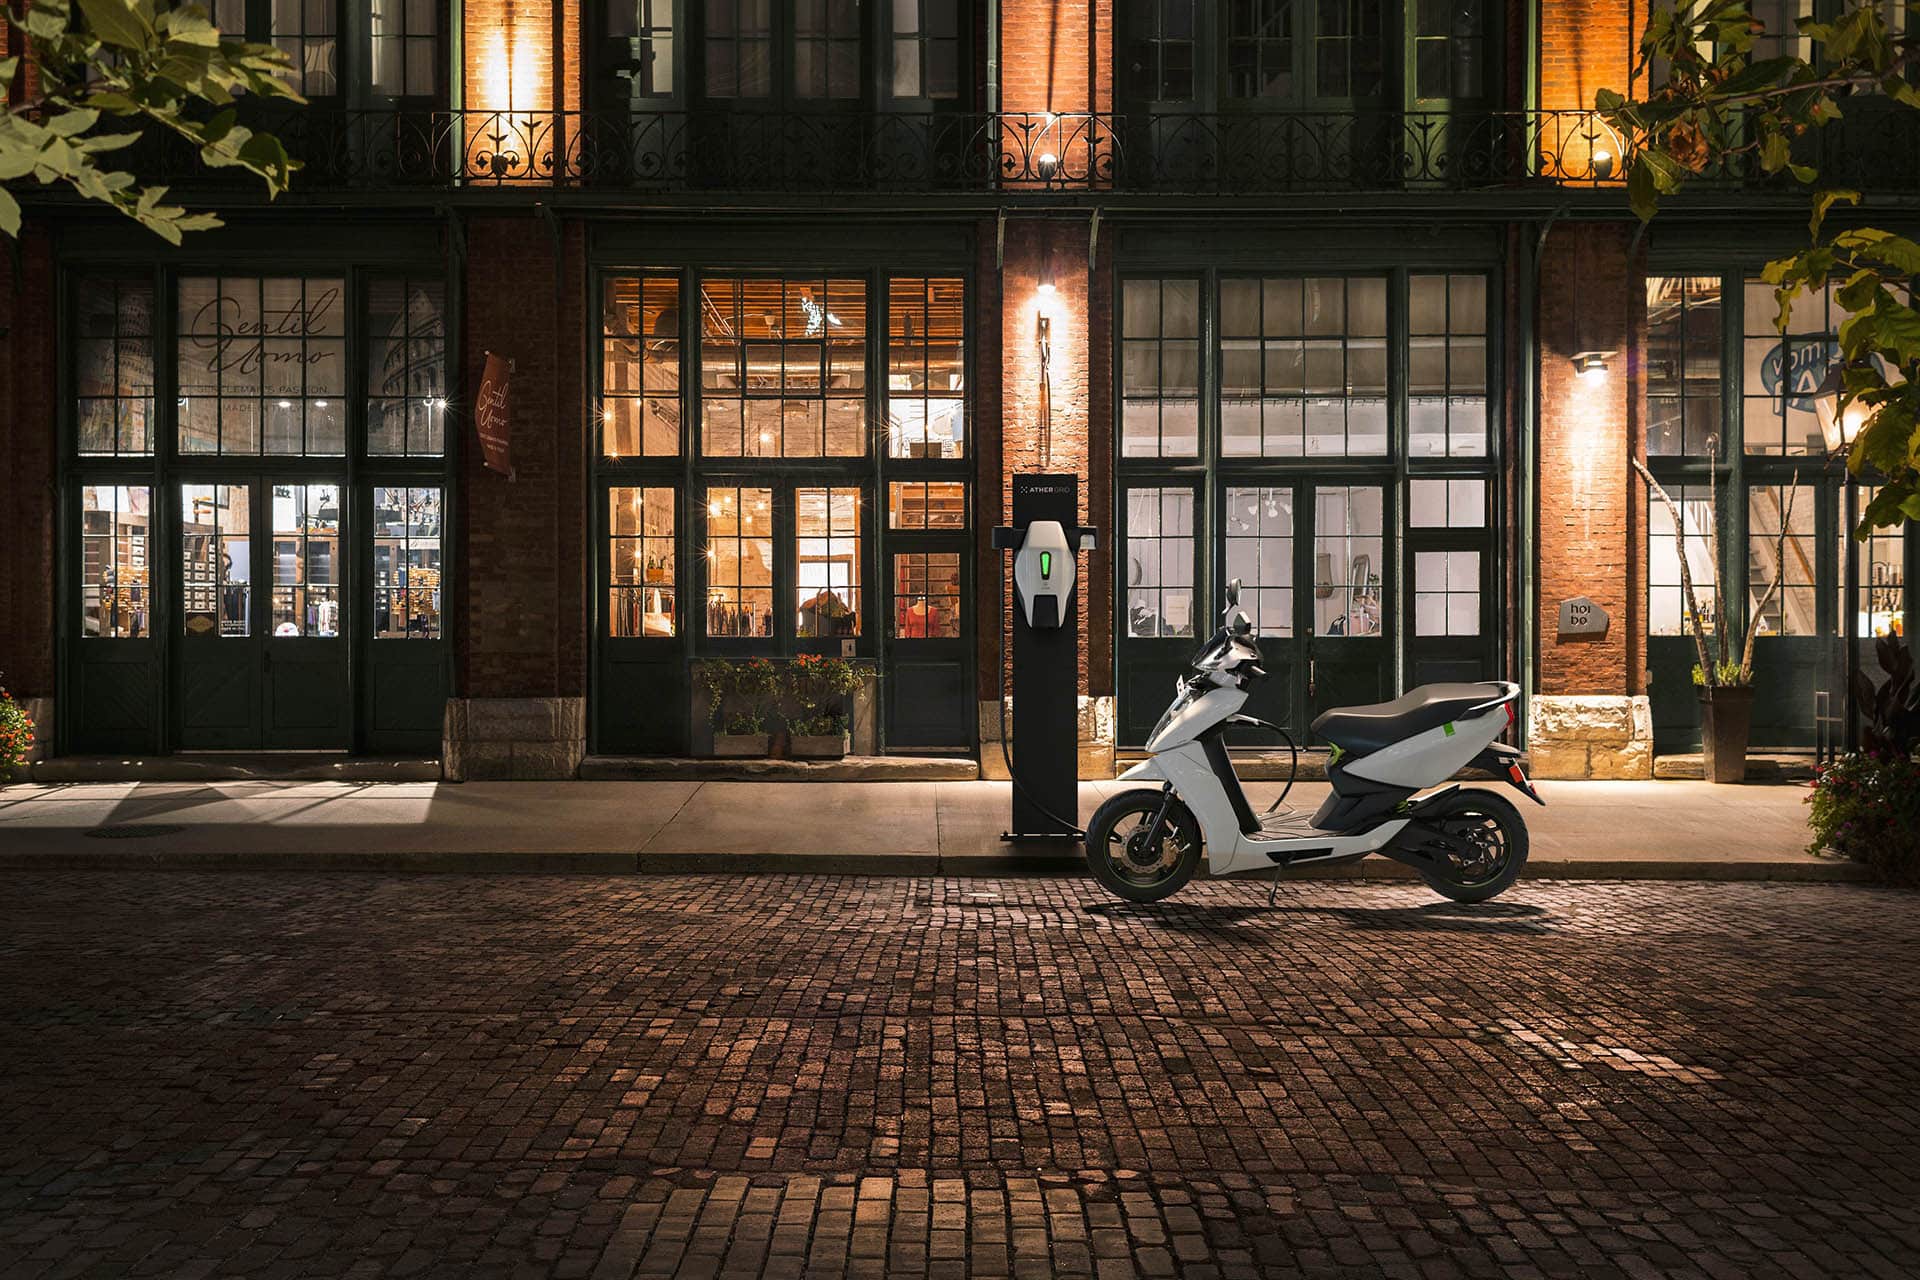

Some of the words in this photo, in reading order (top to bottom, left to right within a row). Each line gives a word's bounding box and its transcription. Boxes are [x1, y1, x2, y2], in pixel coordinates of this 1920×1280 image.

[191, 287, 339, 348] Gentil
[207, 337, 335, 374] Uomo
[1570, 615, 1588, 625] bo
